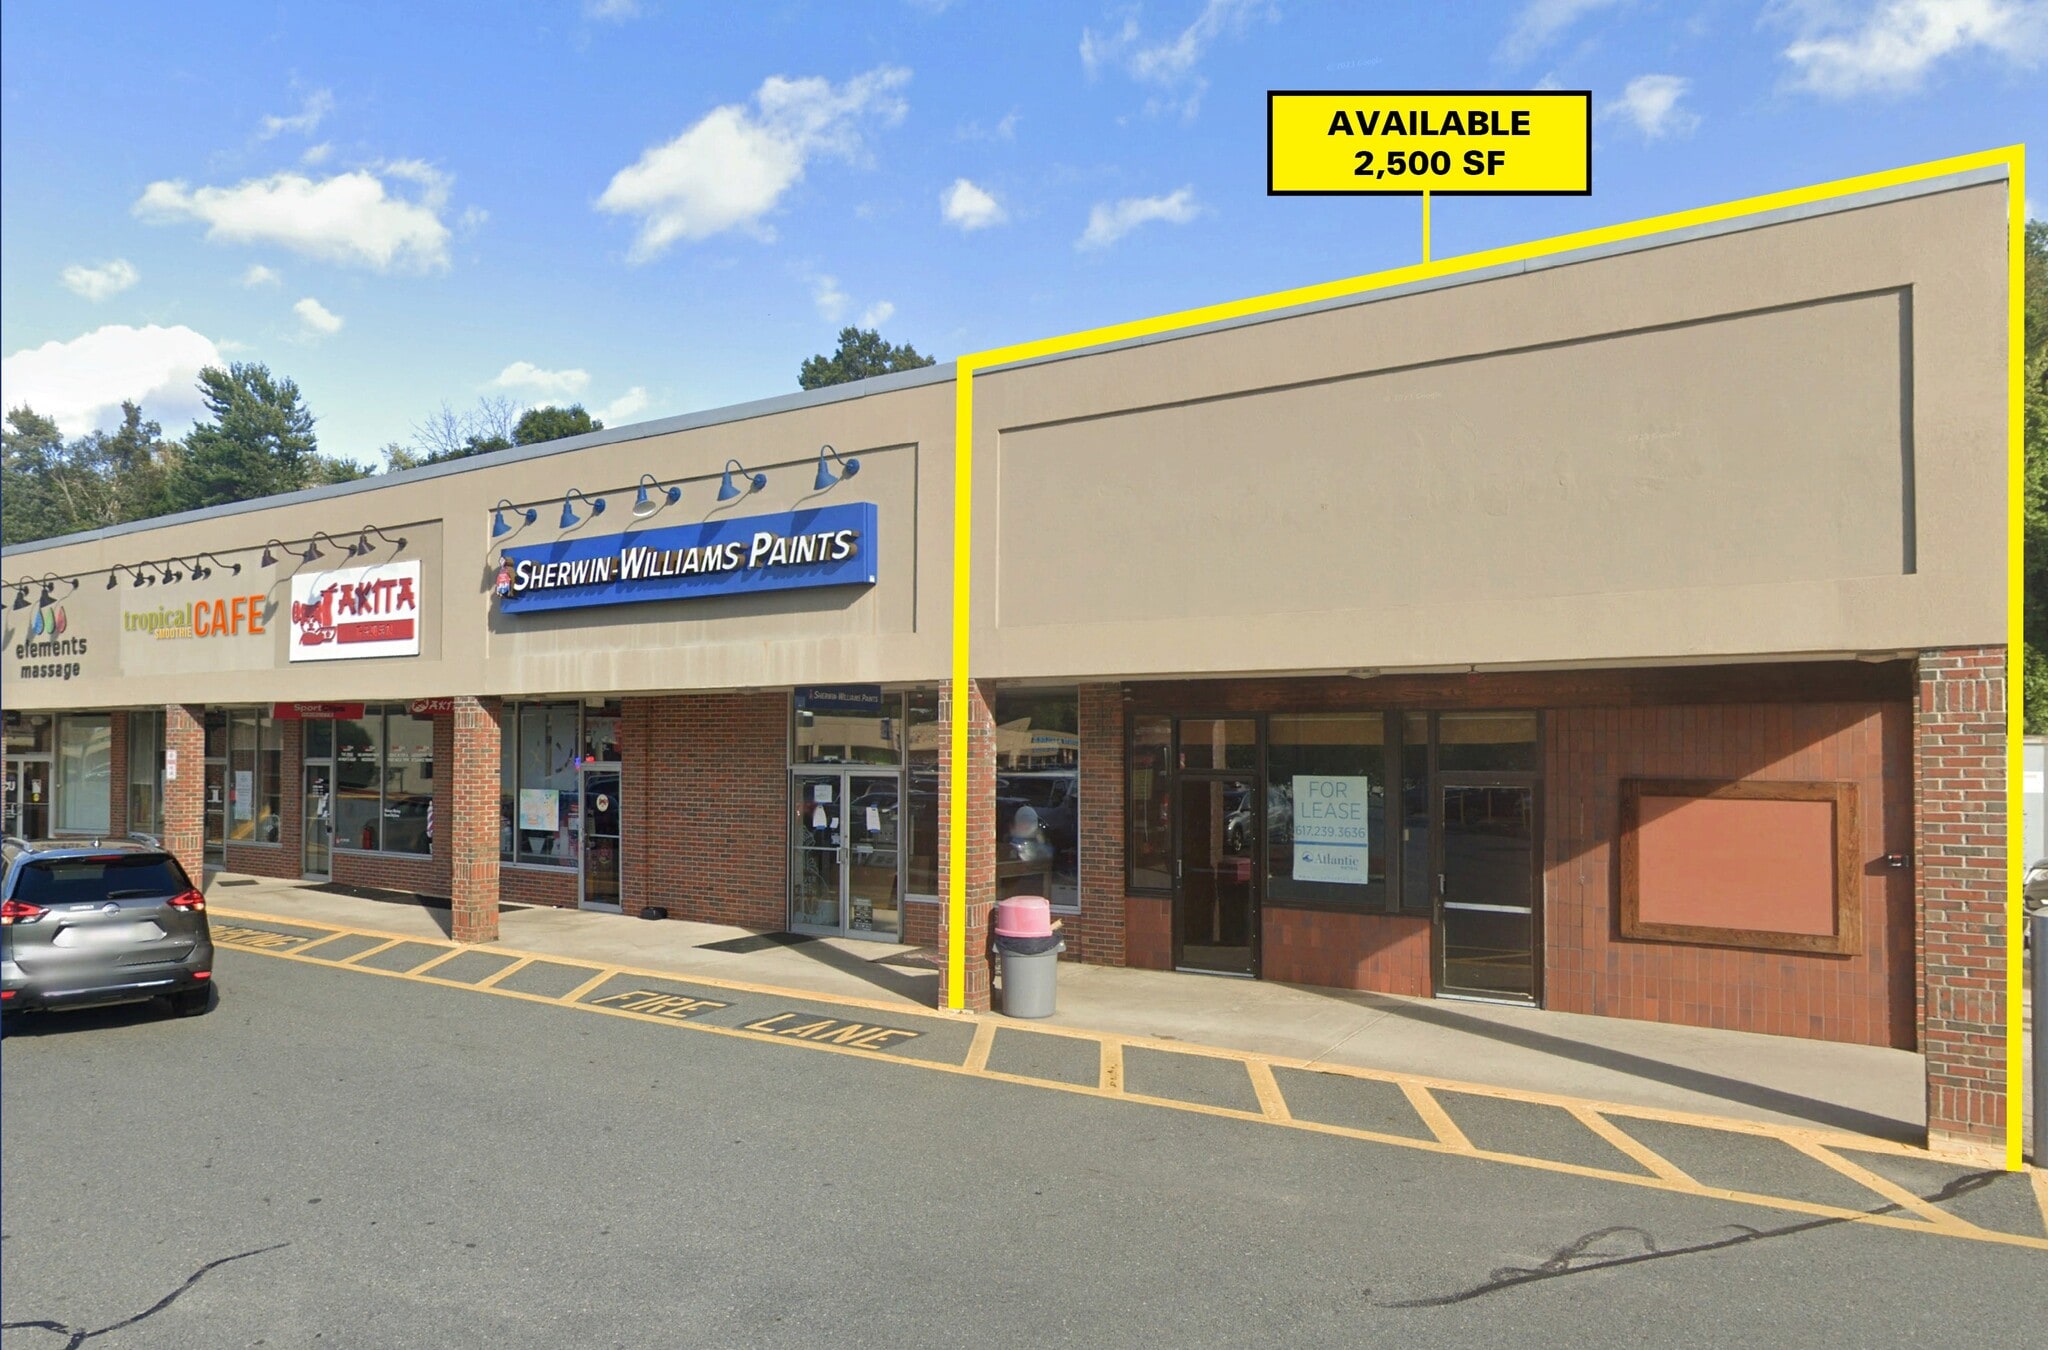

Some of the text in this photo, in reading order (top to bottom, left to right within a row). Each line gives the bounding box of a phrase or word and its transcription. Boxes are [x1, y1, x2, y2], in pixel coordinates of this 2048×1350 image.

[513, 529, 854, 592] SHERWIN-WILLIAMS PAINTS
[337, 577, 416, 616] AKITA
[123, 595, 266, 638] tropical CAFE
[153, 627, 193, 641] SMOOTHIE
[16, 636, 88, 659] elements
[20, 661, 81, 680] massage
[1308, 780, 1348, 799] FOR
[1300, 801, 1361, 820] LEASE
[1295, 825, 1366, 839] 617.239.3636
[1313, 853, 1360, 867] Atlantic
[591, 989, 920, 1050] FIRE LANE
